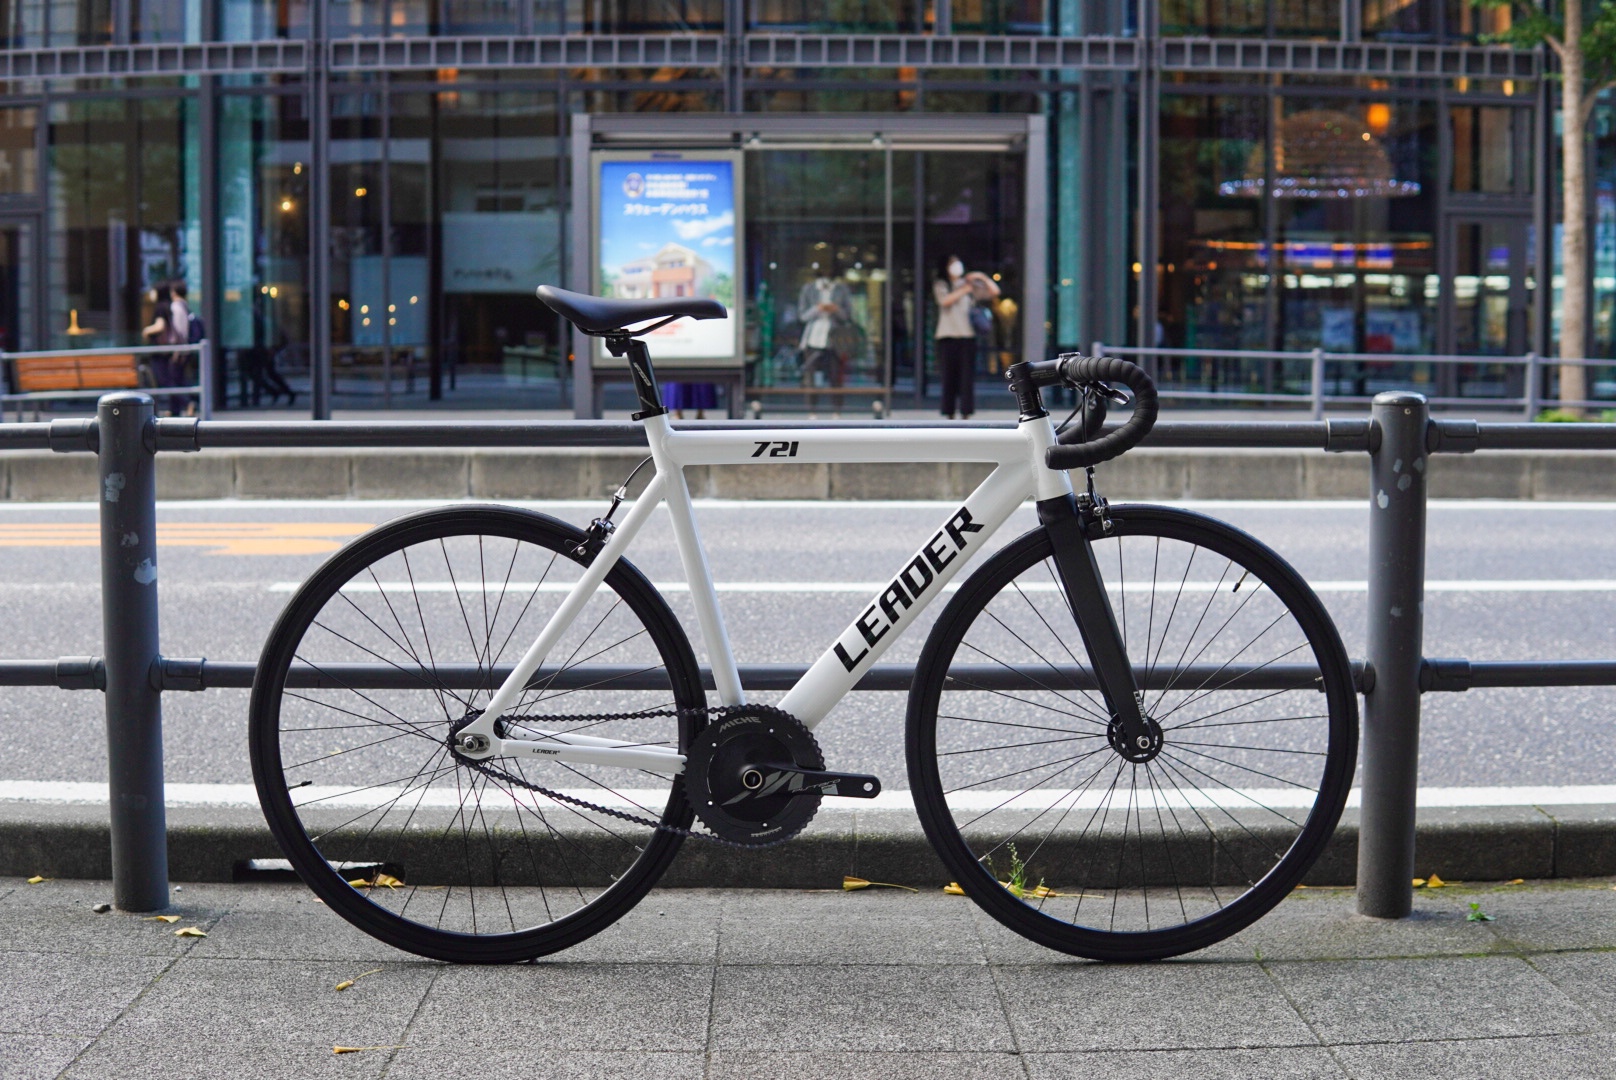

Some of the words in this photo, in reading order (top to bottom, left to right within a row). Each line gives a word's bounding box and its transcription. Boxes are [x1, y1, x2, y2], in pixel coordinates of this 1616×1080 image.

[751, 441, 799, 457] 721
[833, 506, 984, 673] LEADER
[719, 716, 762, 733] MICHE
